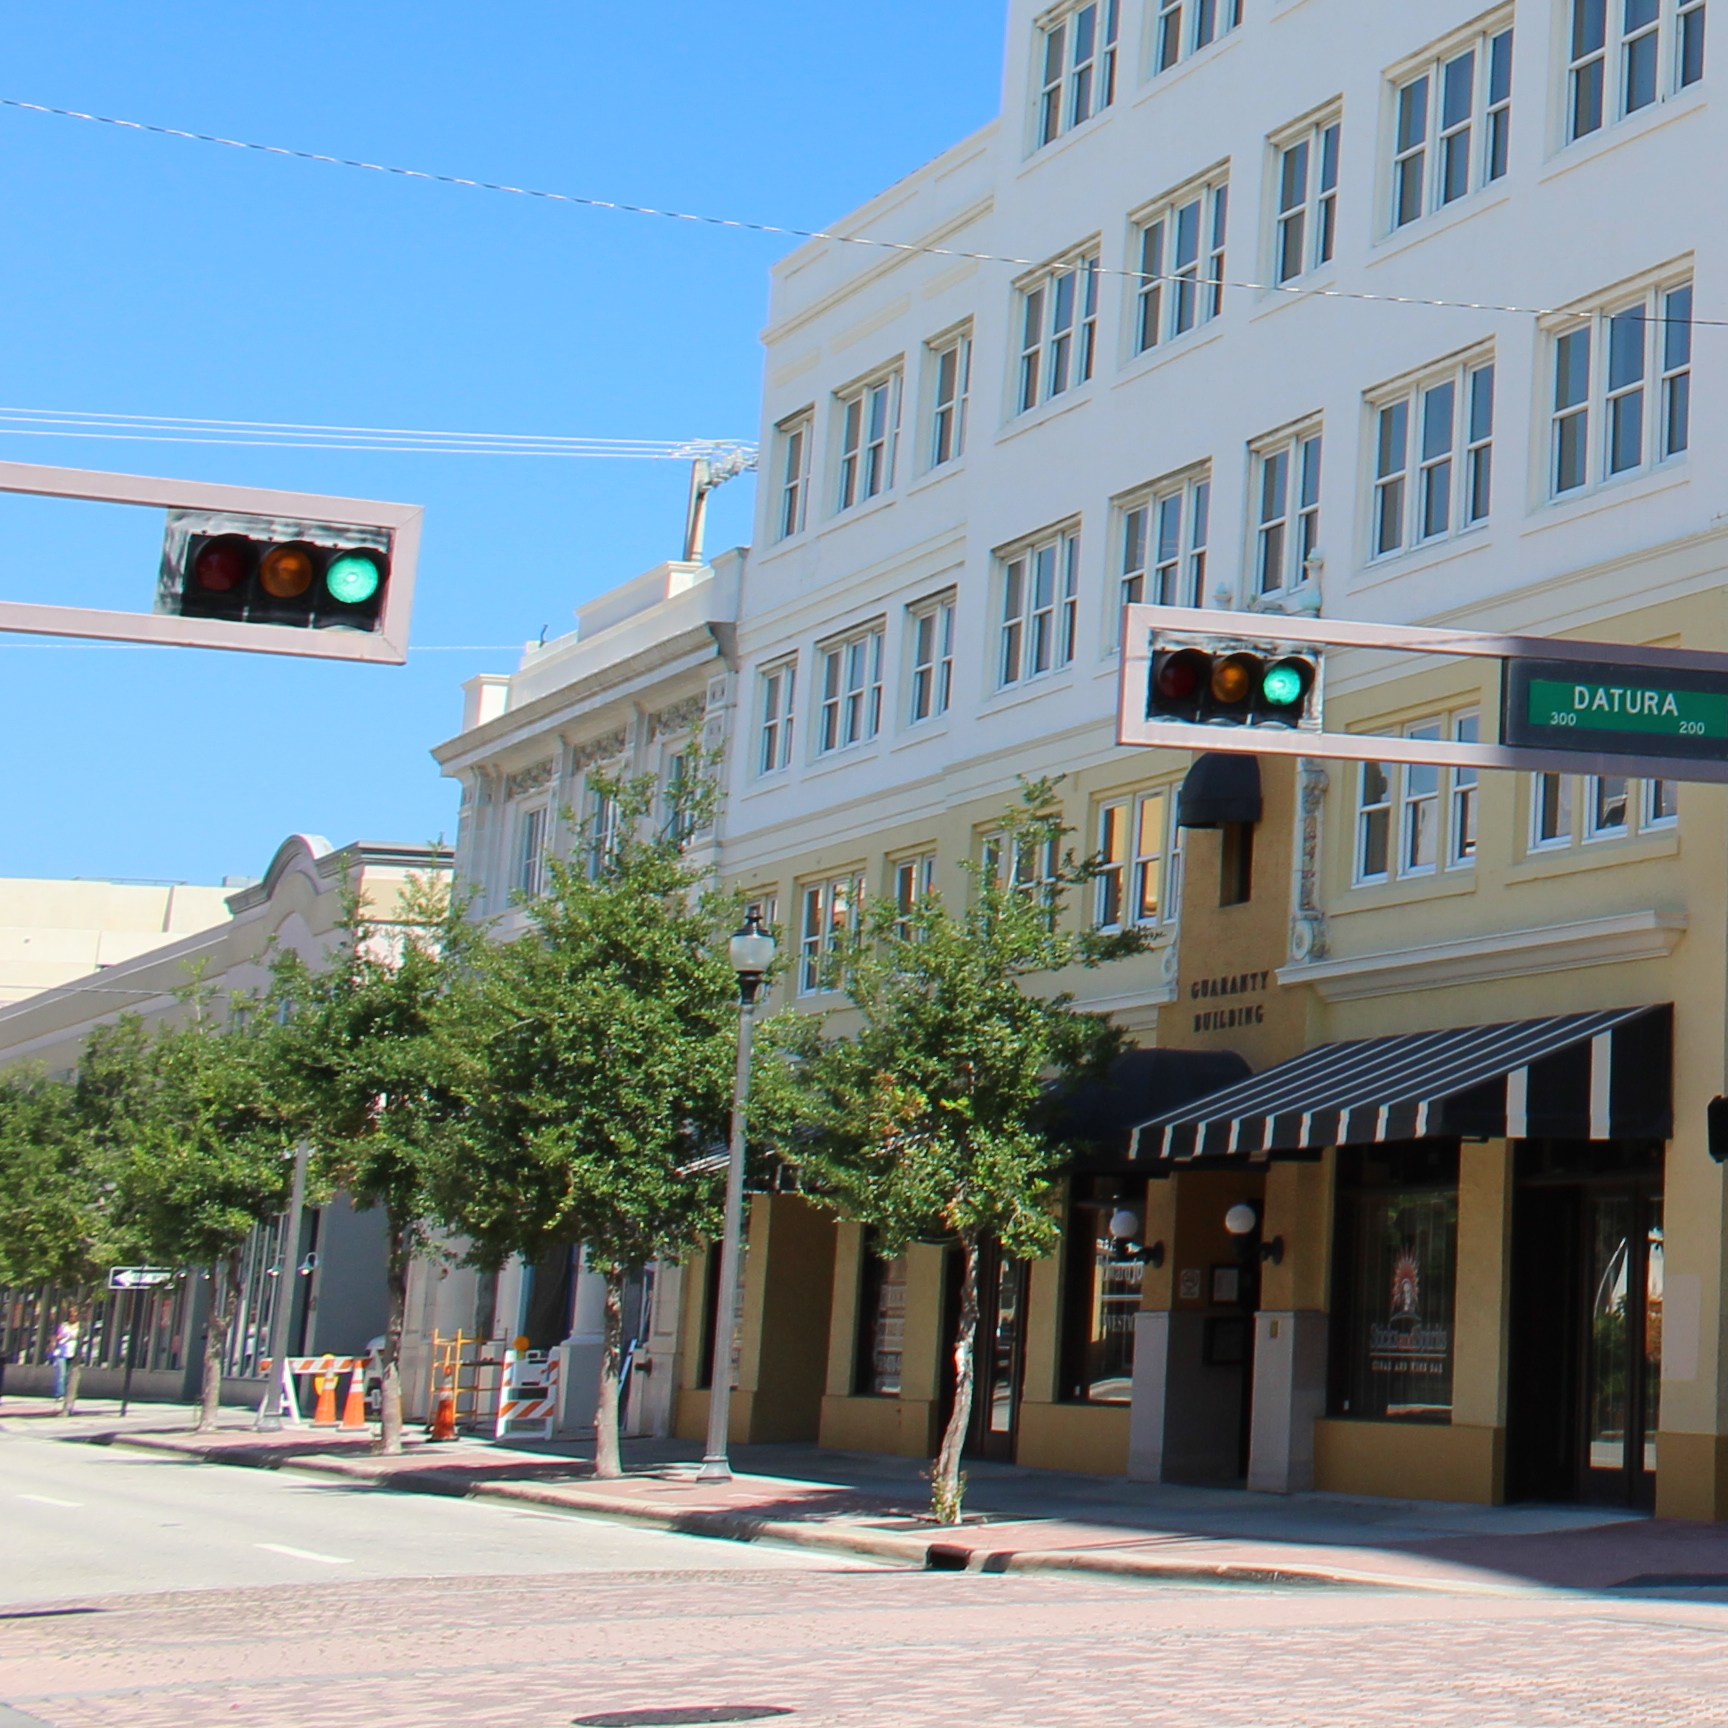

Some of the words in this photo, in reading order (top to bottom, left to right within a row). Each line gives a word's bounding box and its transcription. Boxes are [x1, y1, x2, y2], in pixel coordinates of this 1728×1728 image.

[1573, 685, 1679, 717] DATURA
[1549, 712, 1577, 727] 300
[1678, 721, 1706, 735] 200
[1191, 970, 1269, 999] GUARANTY
[1194, 1004, 1264, 1033] BUILDING
